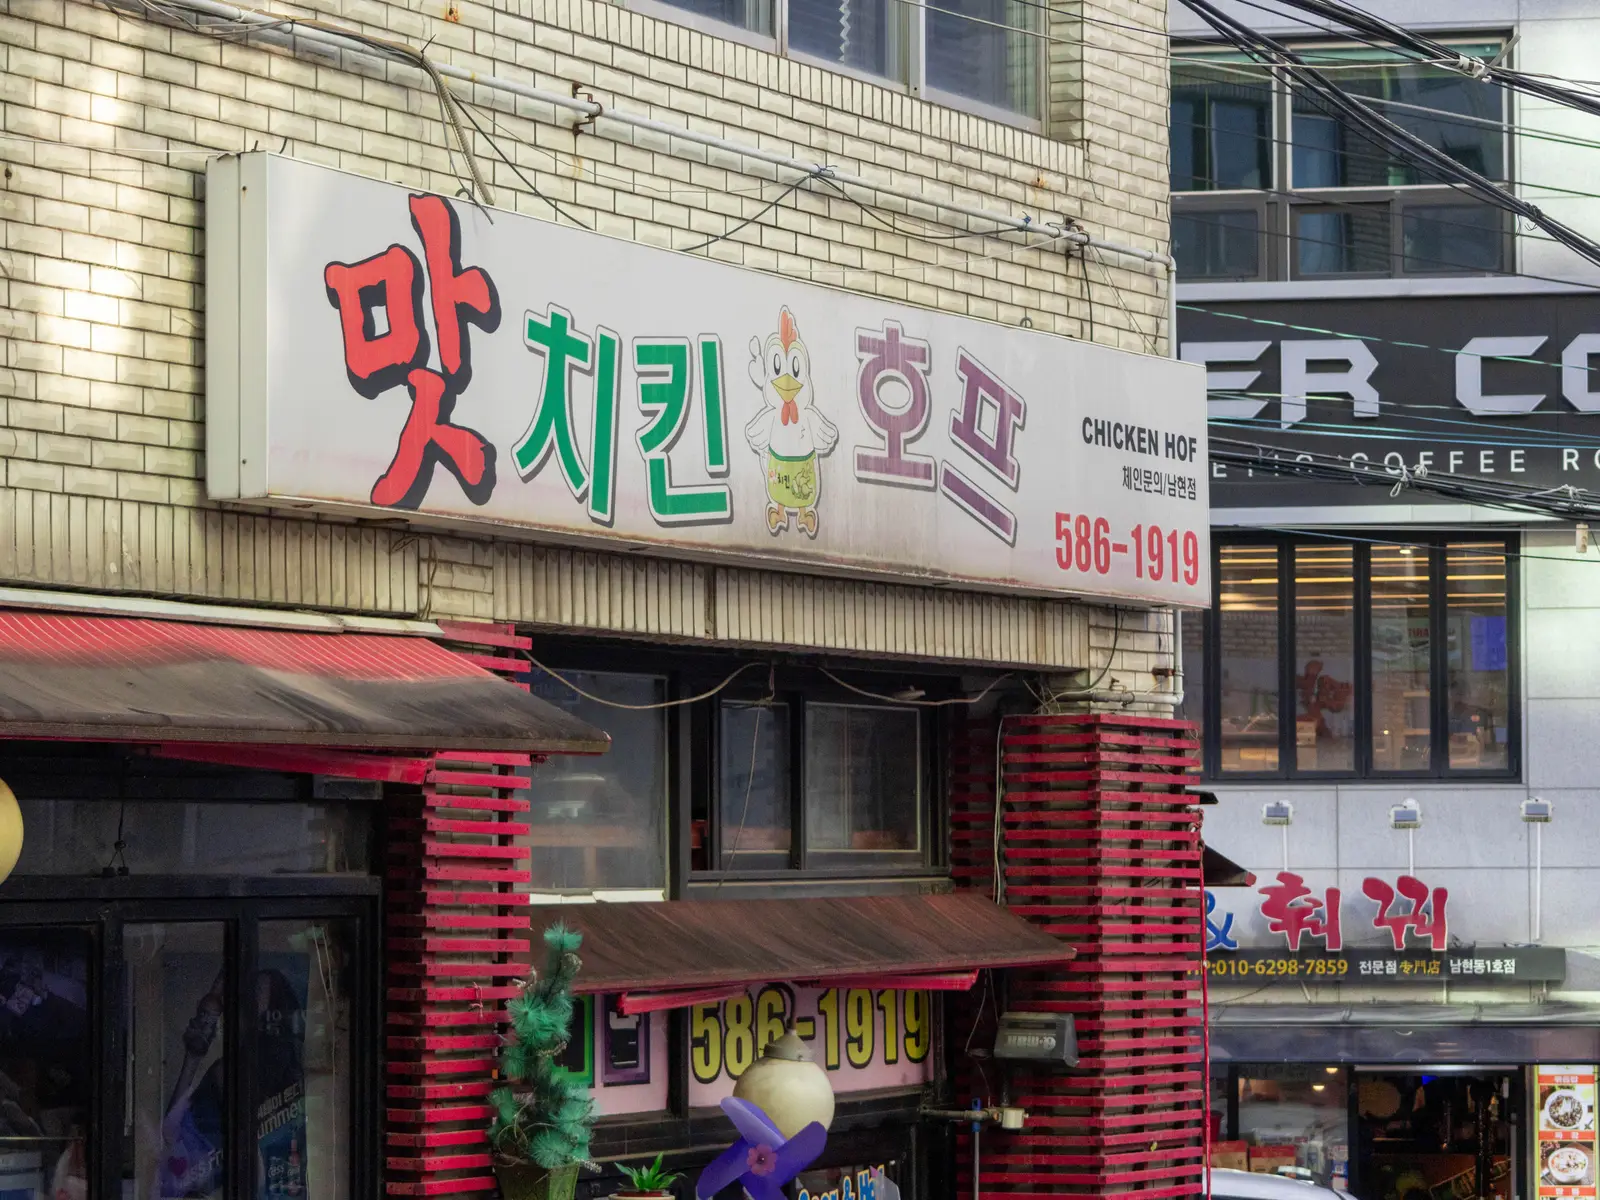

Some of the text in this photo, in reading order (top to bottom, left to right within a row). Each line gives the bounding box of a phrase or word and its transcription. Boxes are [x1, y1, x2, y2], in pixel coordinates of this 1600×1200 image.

[853, 319, 1027, 547] 호프
[1082, 416, 1197, 463] CHICKEN HOF
[1122, 465, 1197, 501] 체인문의/남현점
[1055, 511, 1199, 587] 586-1919
[1358, 959, 1398, 975] 전문점
[1450, 958, 1516, 975] 남현동1호점
[691, 983, 930, 1084] 586-1919
